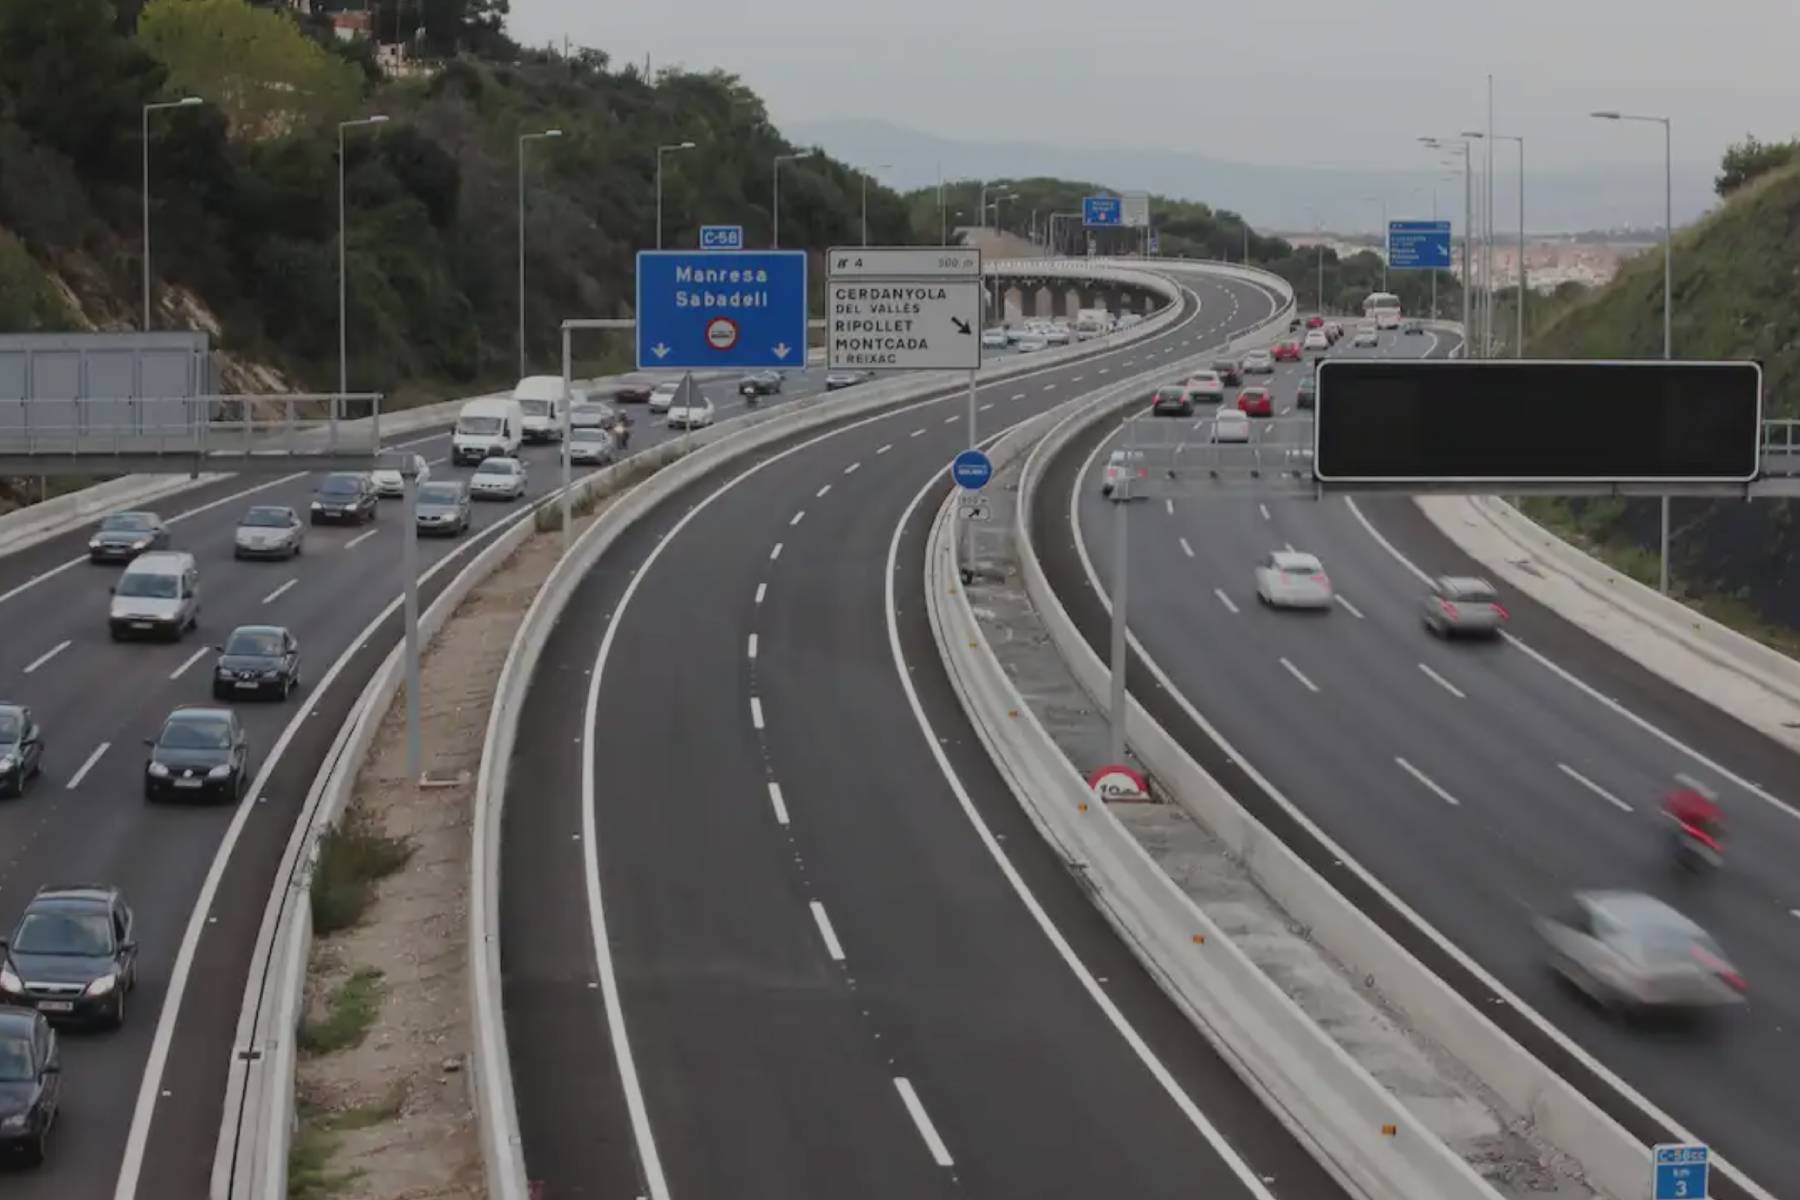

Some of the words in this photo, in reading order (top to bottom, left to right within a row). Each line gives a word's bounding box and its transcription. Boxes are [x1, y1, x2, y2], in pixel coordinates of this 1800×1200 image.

[704, 231, 737, 244] C-58
[676, 266, 768, 283] Manresa
[676, 290, 768, 307] Sabadell
[836, 288, 947, 300] CERDANYOLA
[836, 304, 861, 314] DEL
[836, 320, 913, 332] RIPOLLET
[836, 338, 928, 351] MONTCADA
[846, 353, 896, 364] REIXAC
[1672, 1167, 1691, 1179] km
[1674, 1180, 1688, 1197] 3
